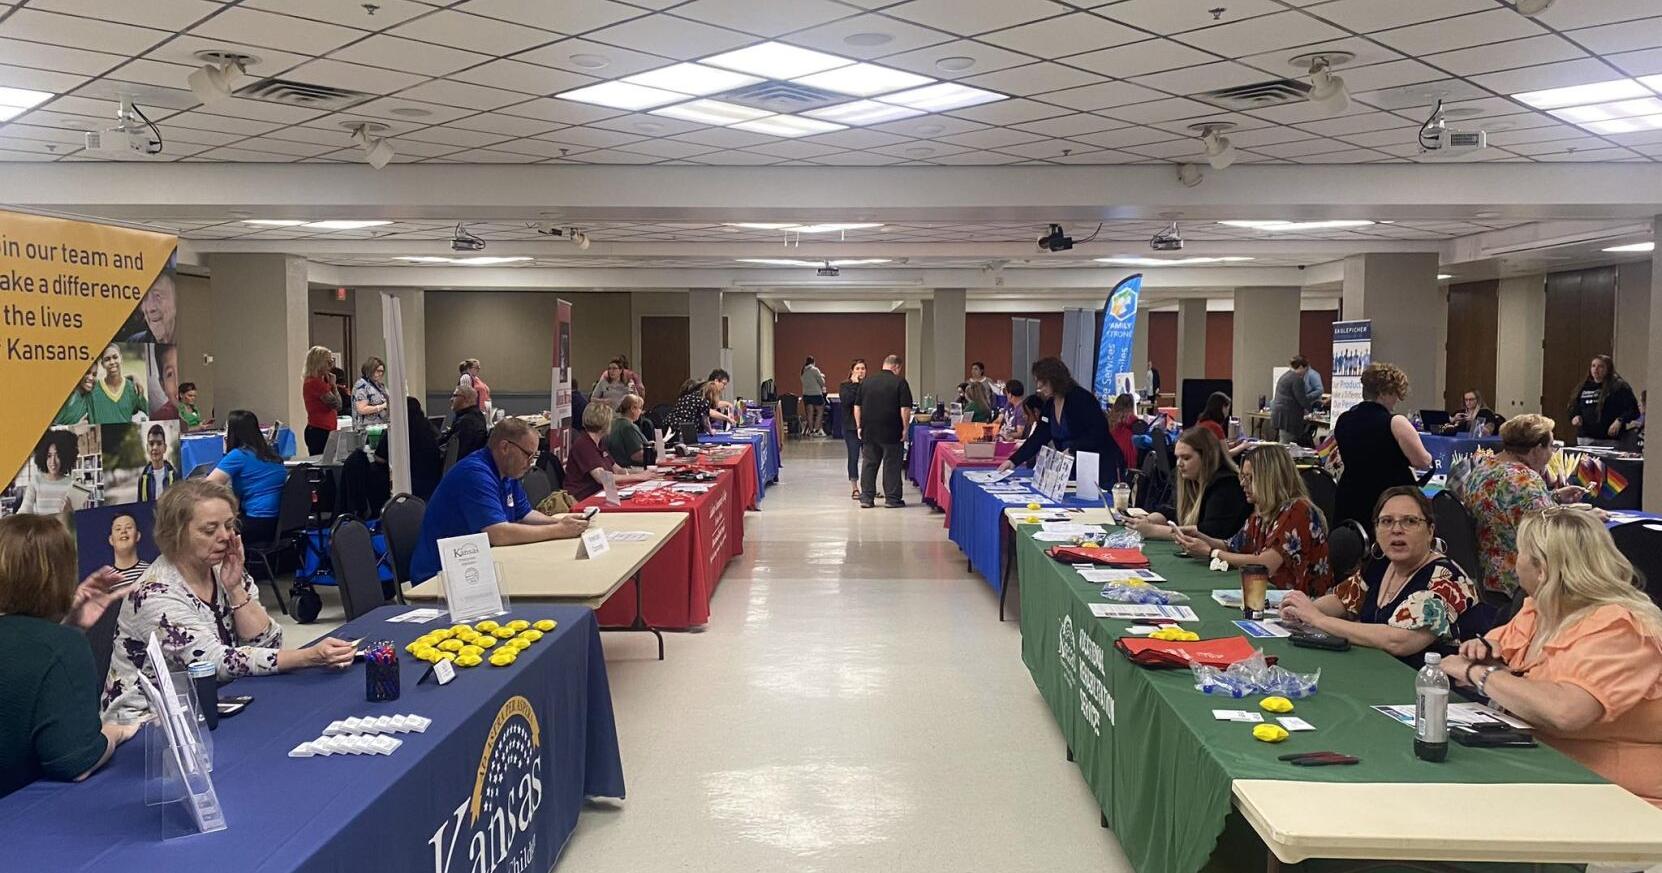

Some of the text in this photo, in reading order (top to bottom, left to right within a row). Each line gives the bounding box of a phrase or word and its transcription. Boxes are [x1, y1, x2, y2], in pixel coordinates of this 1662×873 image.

[0, 234, 143, 271] in our team and
[39, 278, 48, 294] a
[53, 274, 140, 300] difference
[4, 304, 83, 329] the lives
[7, 338, 94, 361] Kansans.
[1102, 344, 1115, 384] Services
[453, 546, 479, 558] Kansas
